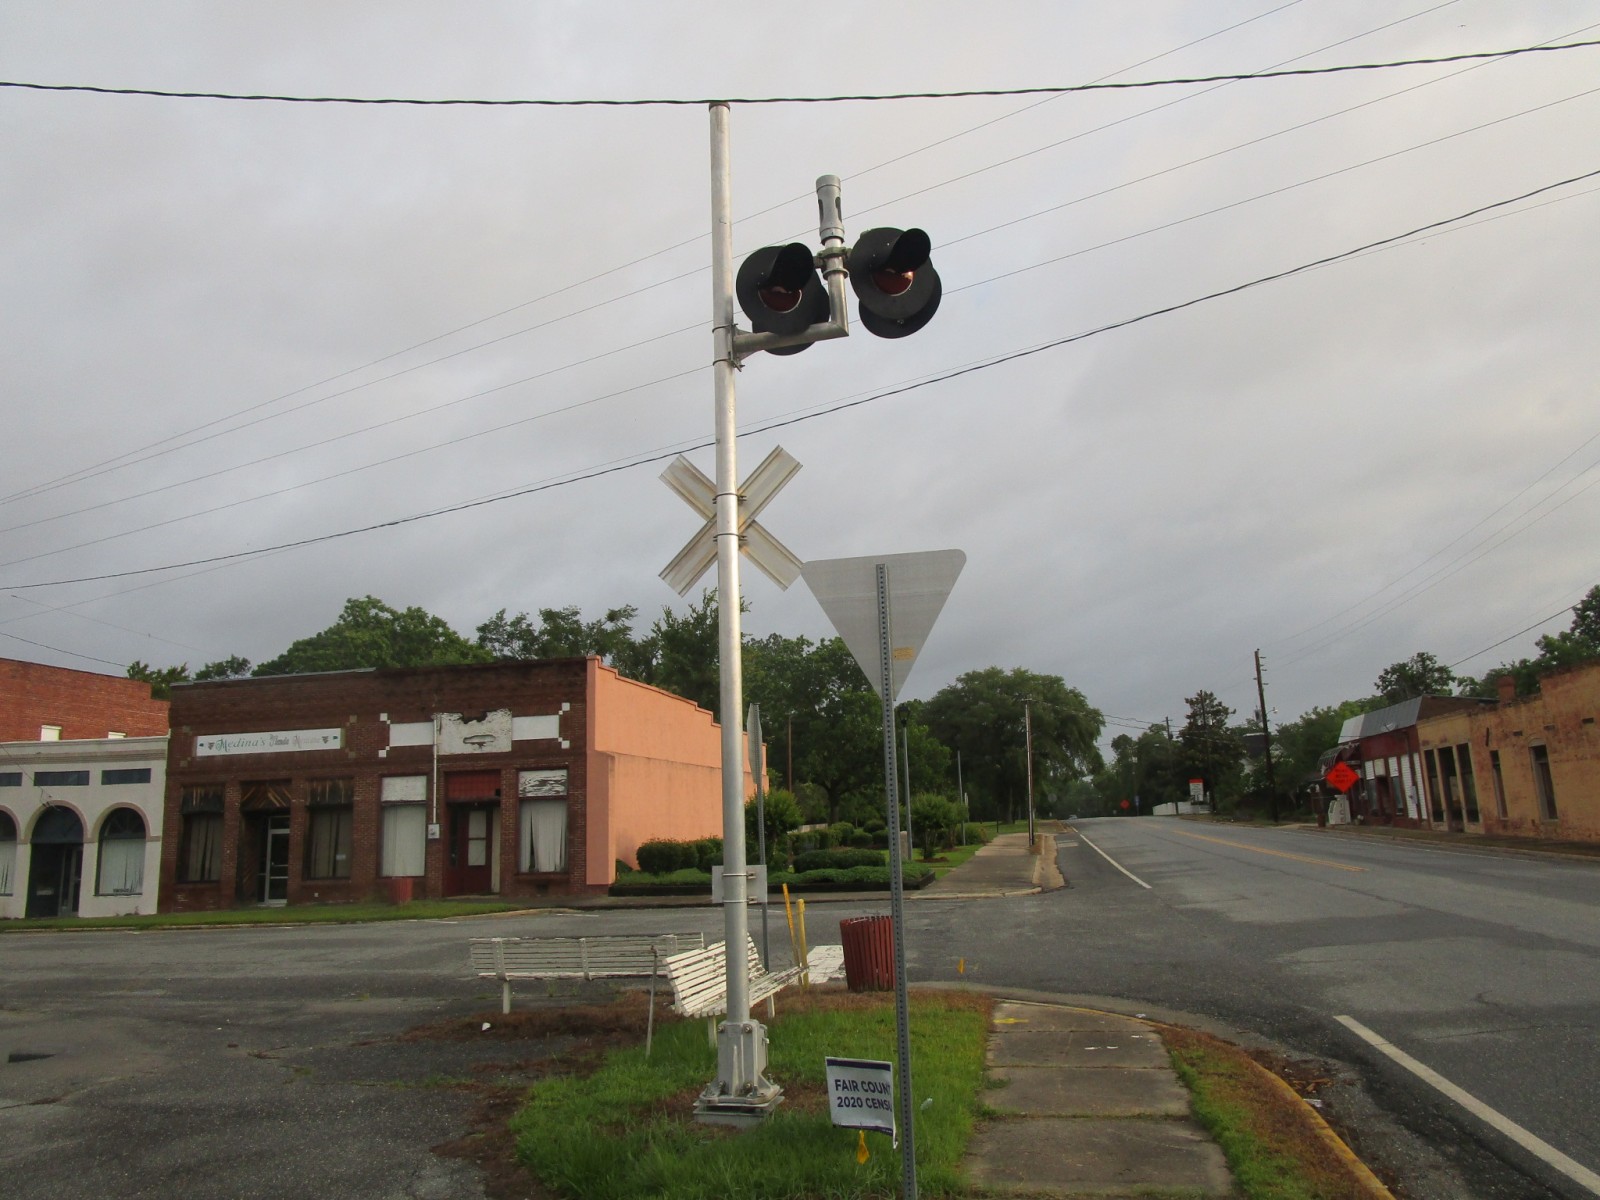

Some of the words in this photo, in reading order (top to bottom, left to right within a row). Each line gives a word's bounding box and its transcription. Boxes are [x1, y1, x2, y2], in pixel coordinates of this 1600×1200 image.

[215, 737, 266, 752] Medina's
[834, 1079, 860, 1092] FAIR
[837, 1096, 863, 1108] 2020
